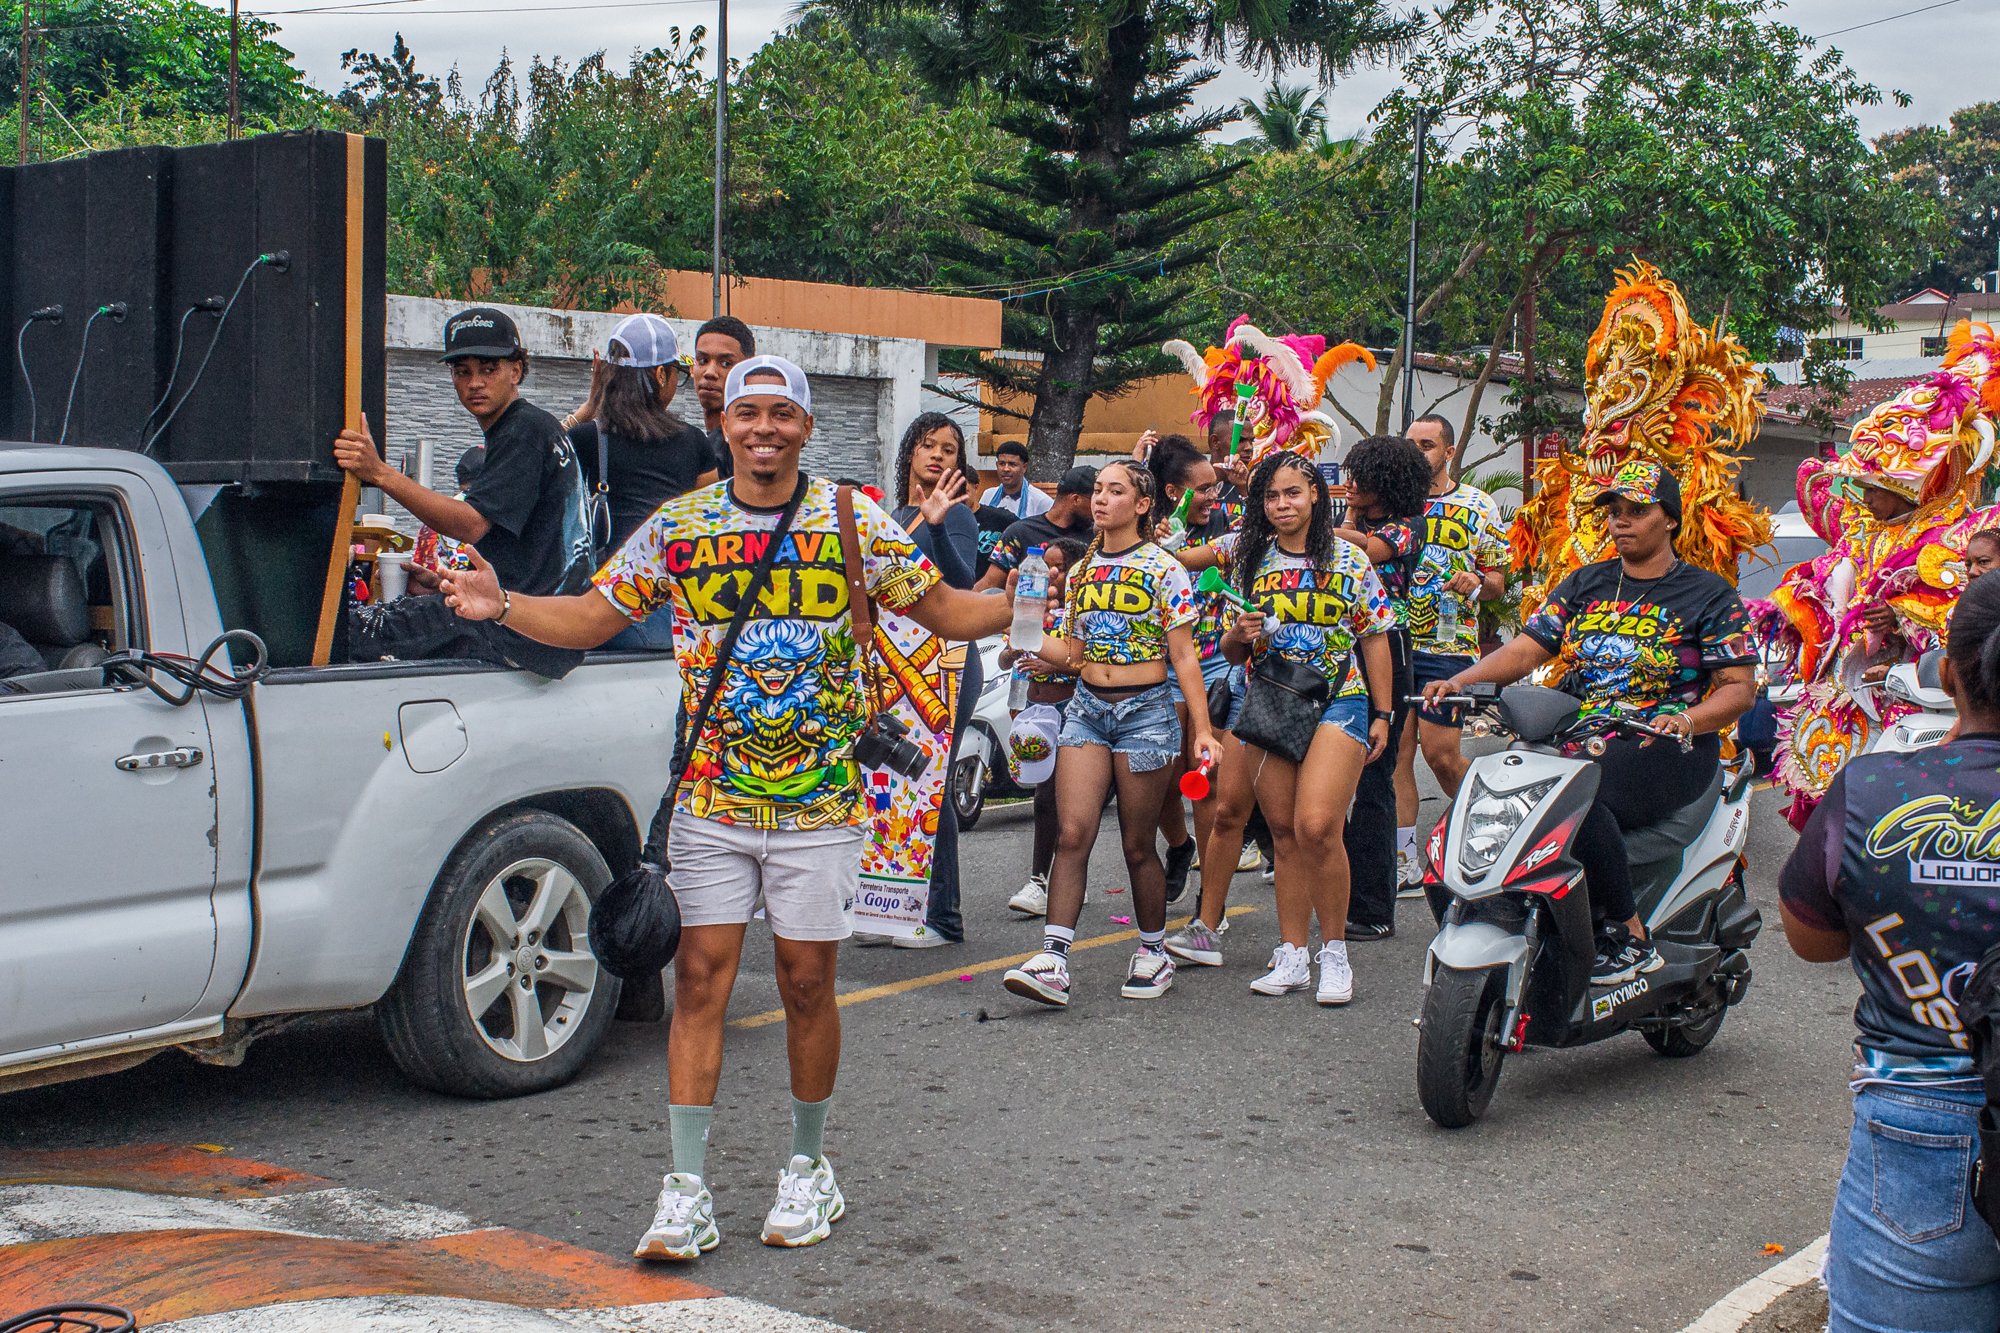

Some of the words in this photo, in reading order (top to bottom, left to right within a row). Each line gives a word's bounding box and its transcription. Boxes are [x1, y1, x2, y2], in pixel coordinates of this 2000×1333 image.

[450, 315, 494, 342] Yankees
[667, 533, 846, 573] CARNAVA
[682, 567, 850, 621] KND
[1251, 569, 1354, 601] ARNAVAL
[1578, 613, 1658, 637] 2026
[1586, 600, 1668, 622] CARNAVAL
[1519, 840, 1563, 871] RS
[864, 892, 900, 913] Goyo
[883, 884, 909, 895] Transporte
[1610, 978, 1648, 1007] KYMCO
